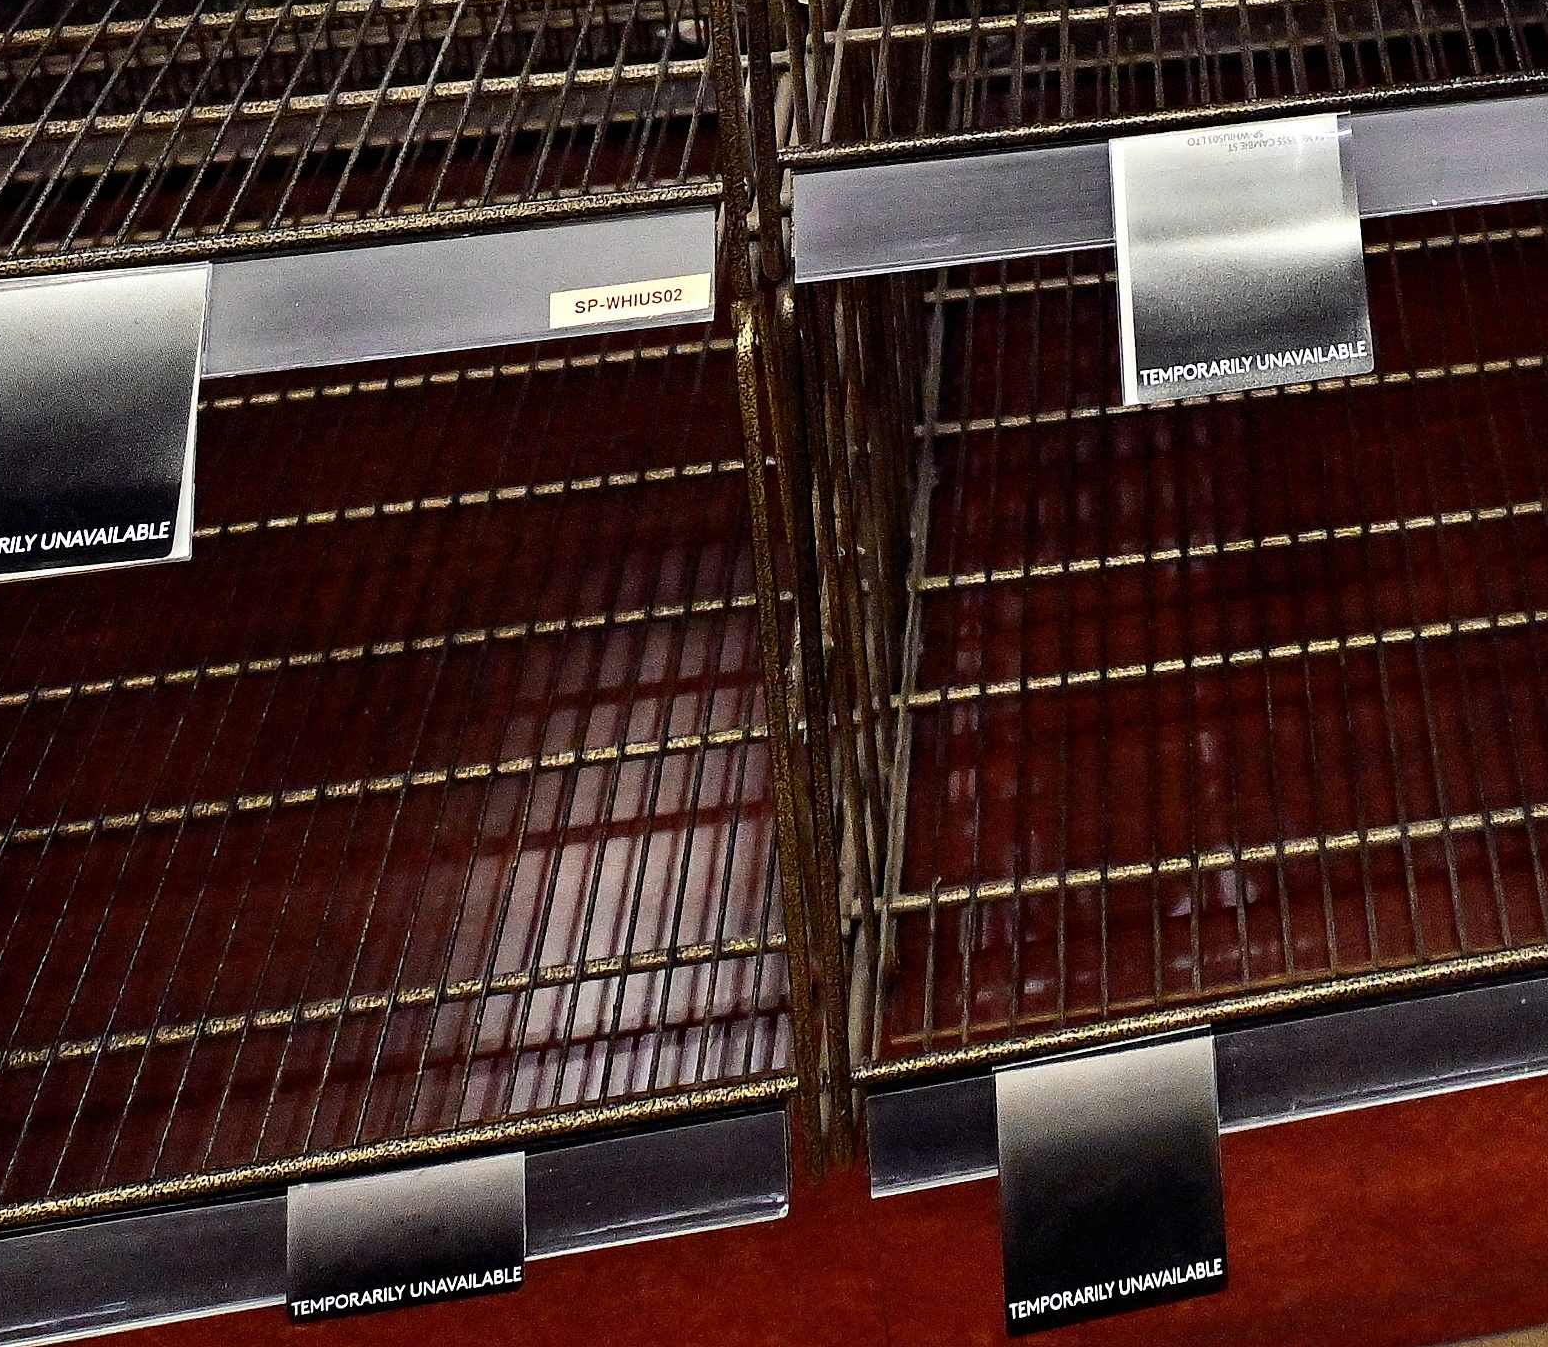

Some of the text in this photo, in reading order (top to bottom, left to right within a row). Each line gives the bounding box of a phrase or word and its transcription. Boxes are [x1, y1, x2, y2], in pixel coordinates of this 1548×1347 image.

[1187, 130, 1263, 147] SP-WHIUS03 LTO
[574, 288, 684, 315] SP-WHIUS02
[1140, 340, 1367, 387] TEMPORARILY UNAVAILABLE
[41, 521, 169, 552] UNAVAILABLE
[291, 1266, 523, 1317] TEMPORARILY UNAVAILABLE
[1008, 1257, 1224, 1321] TEMPORARILY UNAVAILABLE
